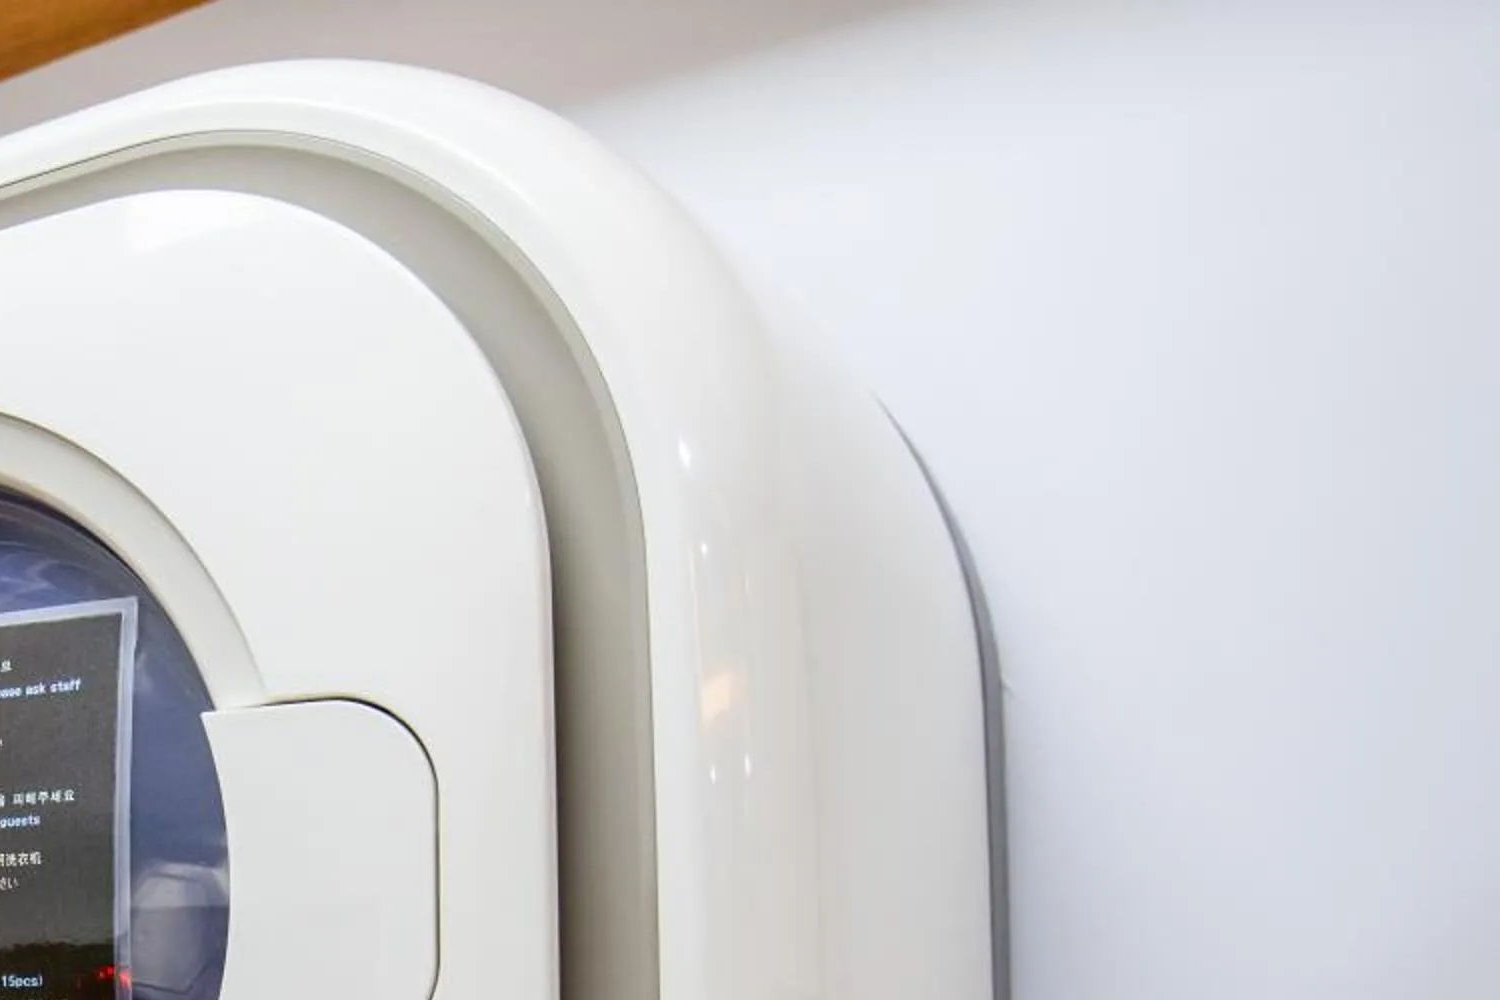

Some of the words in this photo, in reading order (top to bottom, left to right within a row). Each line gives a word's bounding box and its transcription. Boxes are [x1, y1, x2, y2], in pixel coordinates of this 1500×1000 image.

[25, 682, 47, 695] ask
[50, 678, 81, 693] staff
[0, 814, 41, 829] guests
[1, 974, 43, 988] 15pcs)
